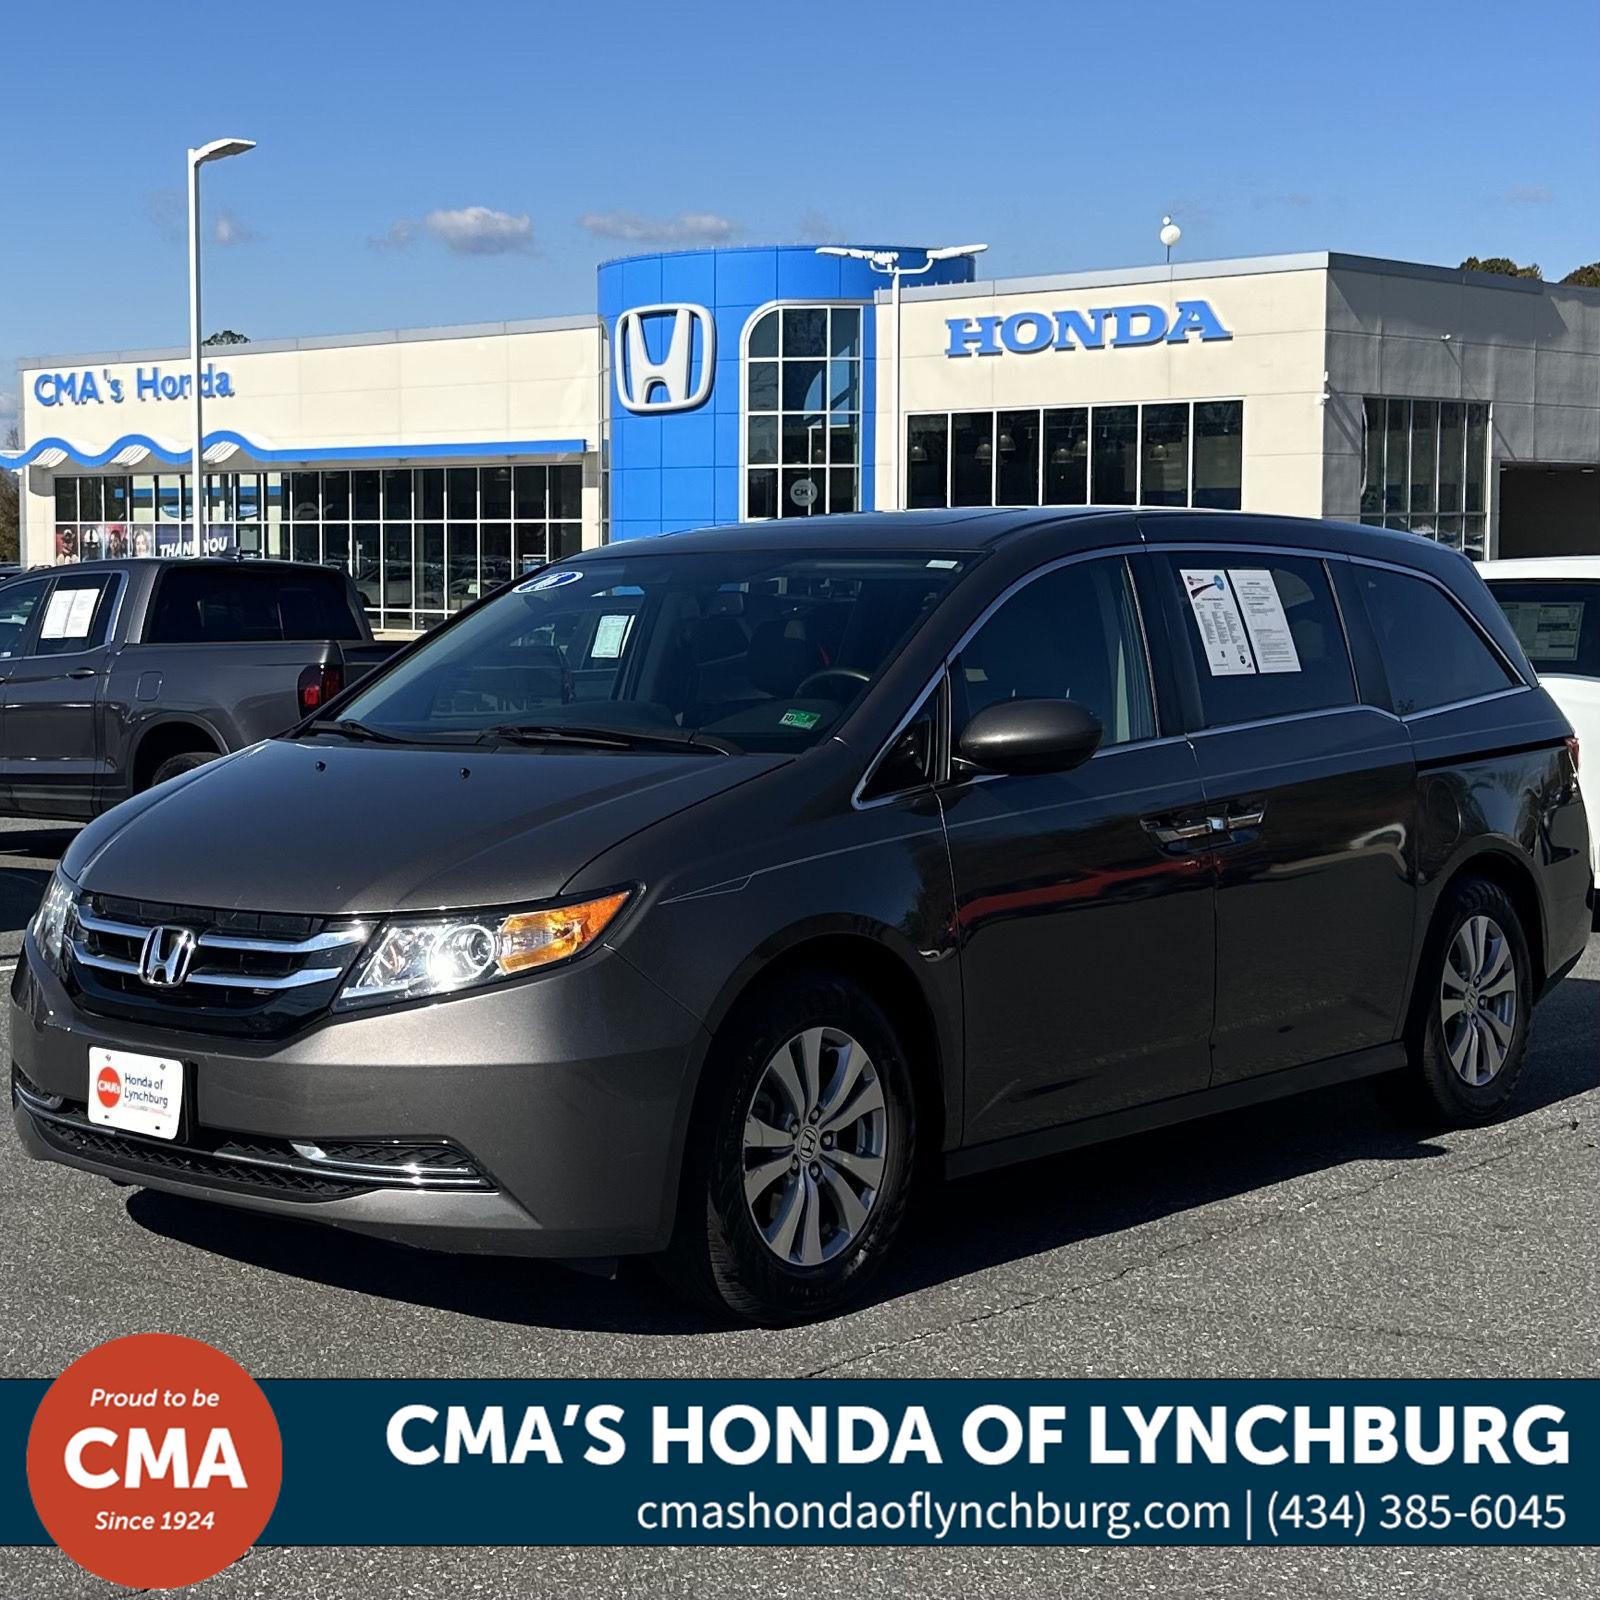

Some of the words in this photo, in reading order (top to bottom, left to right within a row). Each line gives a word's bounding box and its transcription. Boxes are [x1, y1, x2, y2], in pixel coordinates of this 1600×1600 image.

[945, 300, 1233, 358] HONDA
[34, 369, 125, 406] CMA's
[160, 541, 199, 558] THAN
[124, 1073, 153, 1088] Honda
[154, 1079, 163, 1091] of
[124, 1087, 169, 1109] Lynchburg
